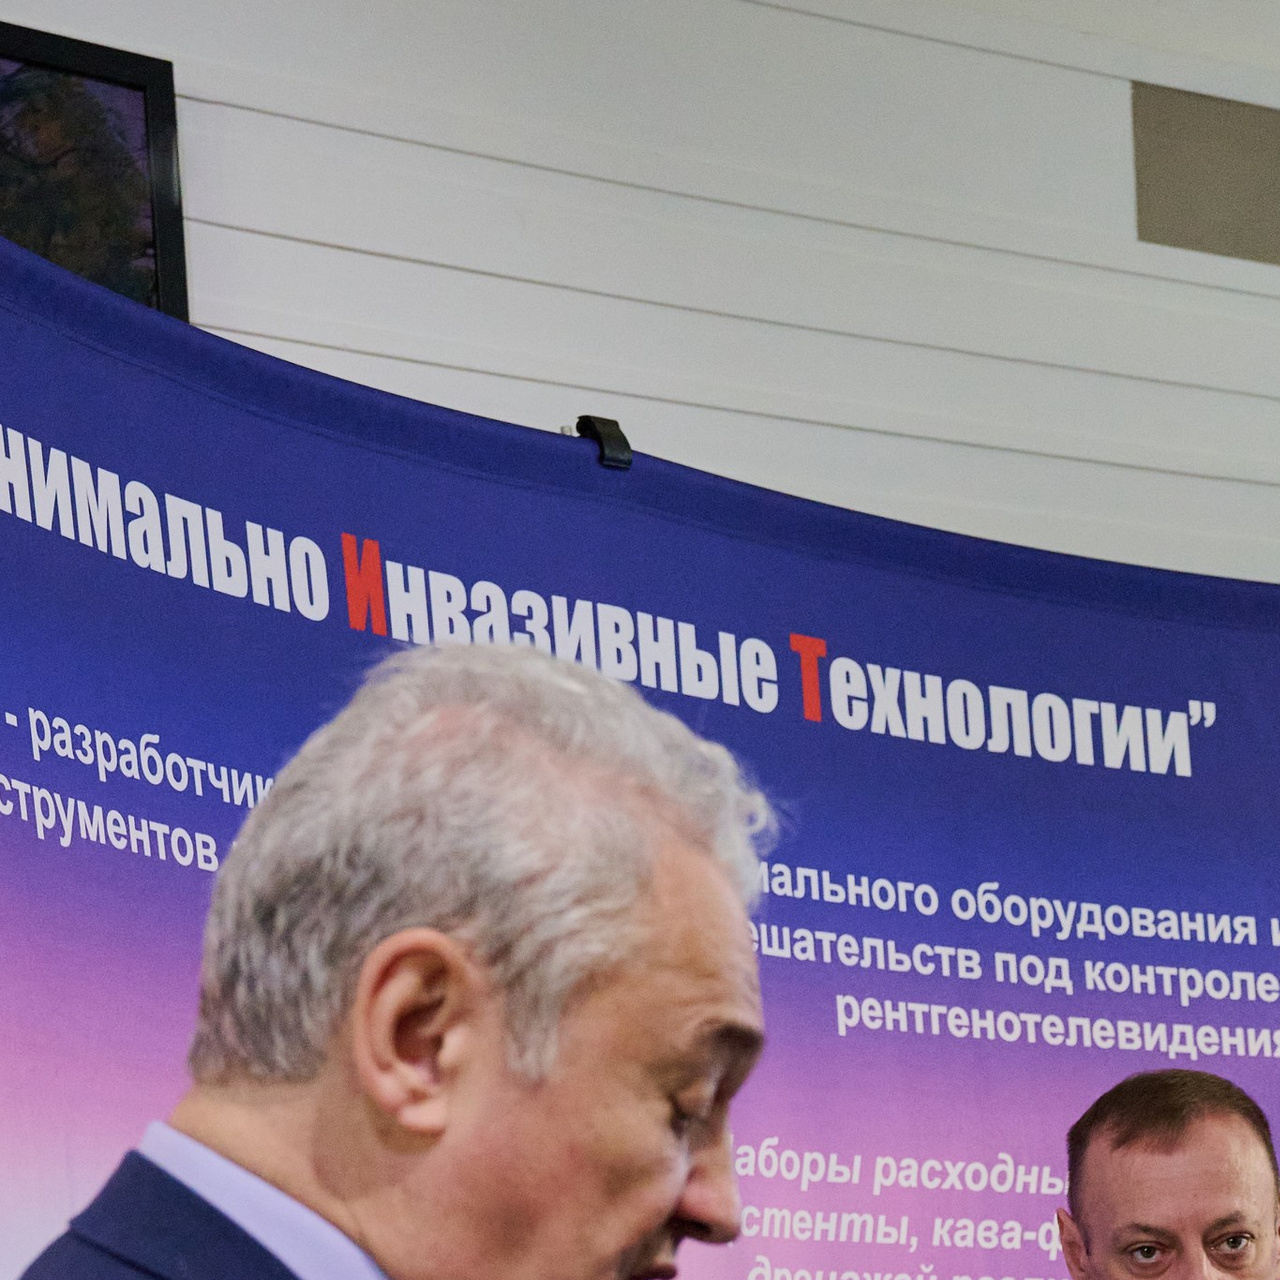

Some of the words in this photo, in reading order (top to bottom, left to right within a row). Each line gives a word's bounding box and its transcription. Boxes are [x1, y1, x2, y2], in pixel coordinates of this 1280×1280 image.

[340, 532, 779, 714] Инвазивные
[951, 881, 1258, 946] оборудования
[994, 951, 1074, 995] под
[731, 1133, 863, 1192] аборы
[740, 1204, 919, 1253] стенты,
